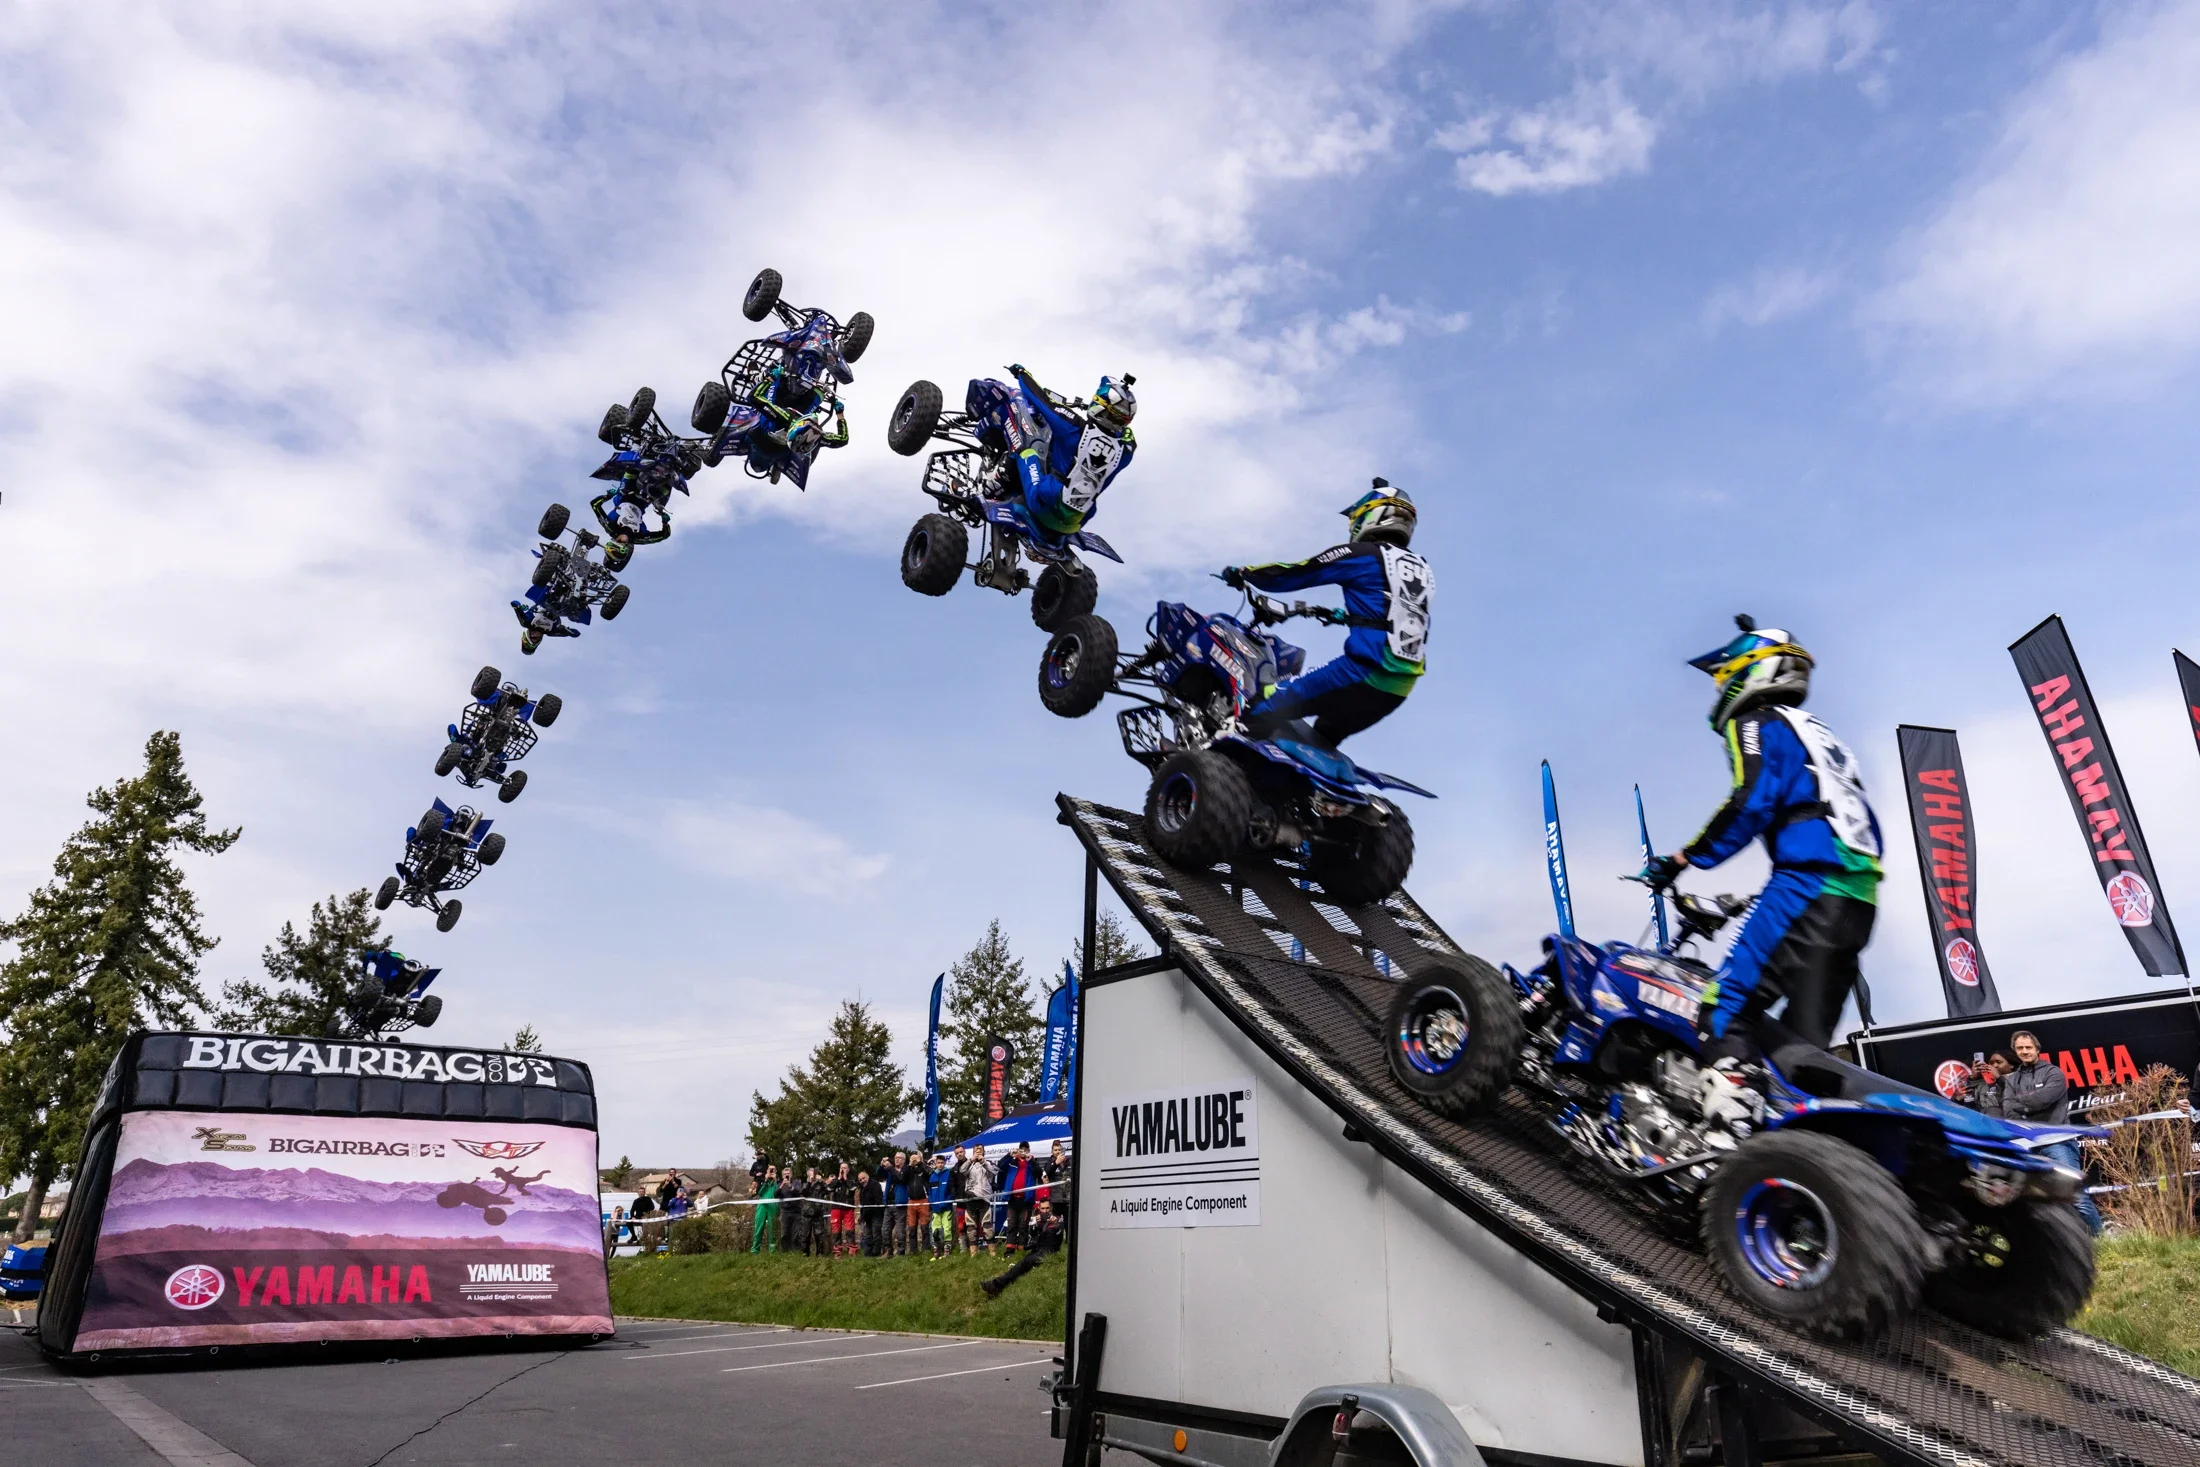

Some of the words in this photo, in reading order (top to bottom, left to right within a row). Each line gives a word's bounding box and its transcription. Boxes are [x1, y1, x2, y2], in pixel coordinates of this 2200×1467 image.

[1004, 417, 1022, 450] YAMAHA
[1317, 546, 1352, 563] YAMAHA
[1918, 769, 1973, 931] YAMAHA
[182, 1036, 486, 1083] BIGAIRBAG
[1049, 1026, 1065, 1076] YAMAHA
[268, 1138, 409, 1157] BIGAIRBAG
[1111, 1199, 1118, 1213] A
[1120, 1198, 1148, 1216] Liquid
[1151, 1197, 1183, 1215] Engine
[1185, 1194, 1247, 1214] Component
[233, 1265, 432, 1307] YAMAHA
[516, 1293, 552, 1301] Component
